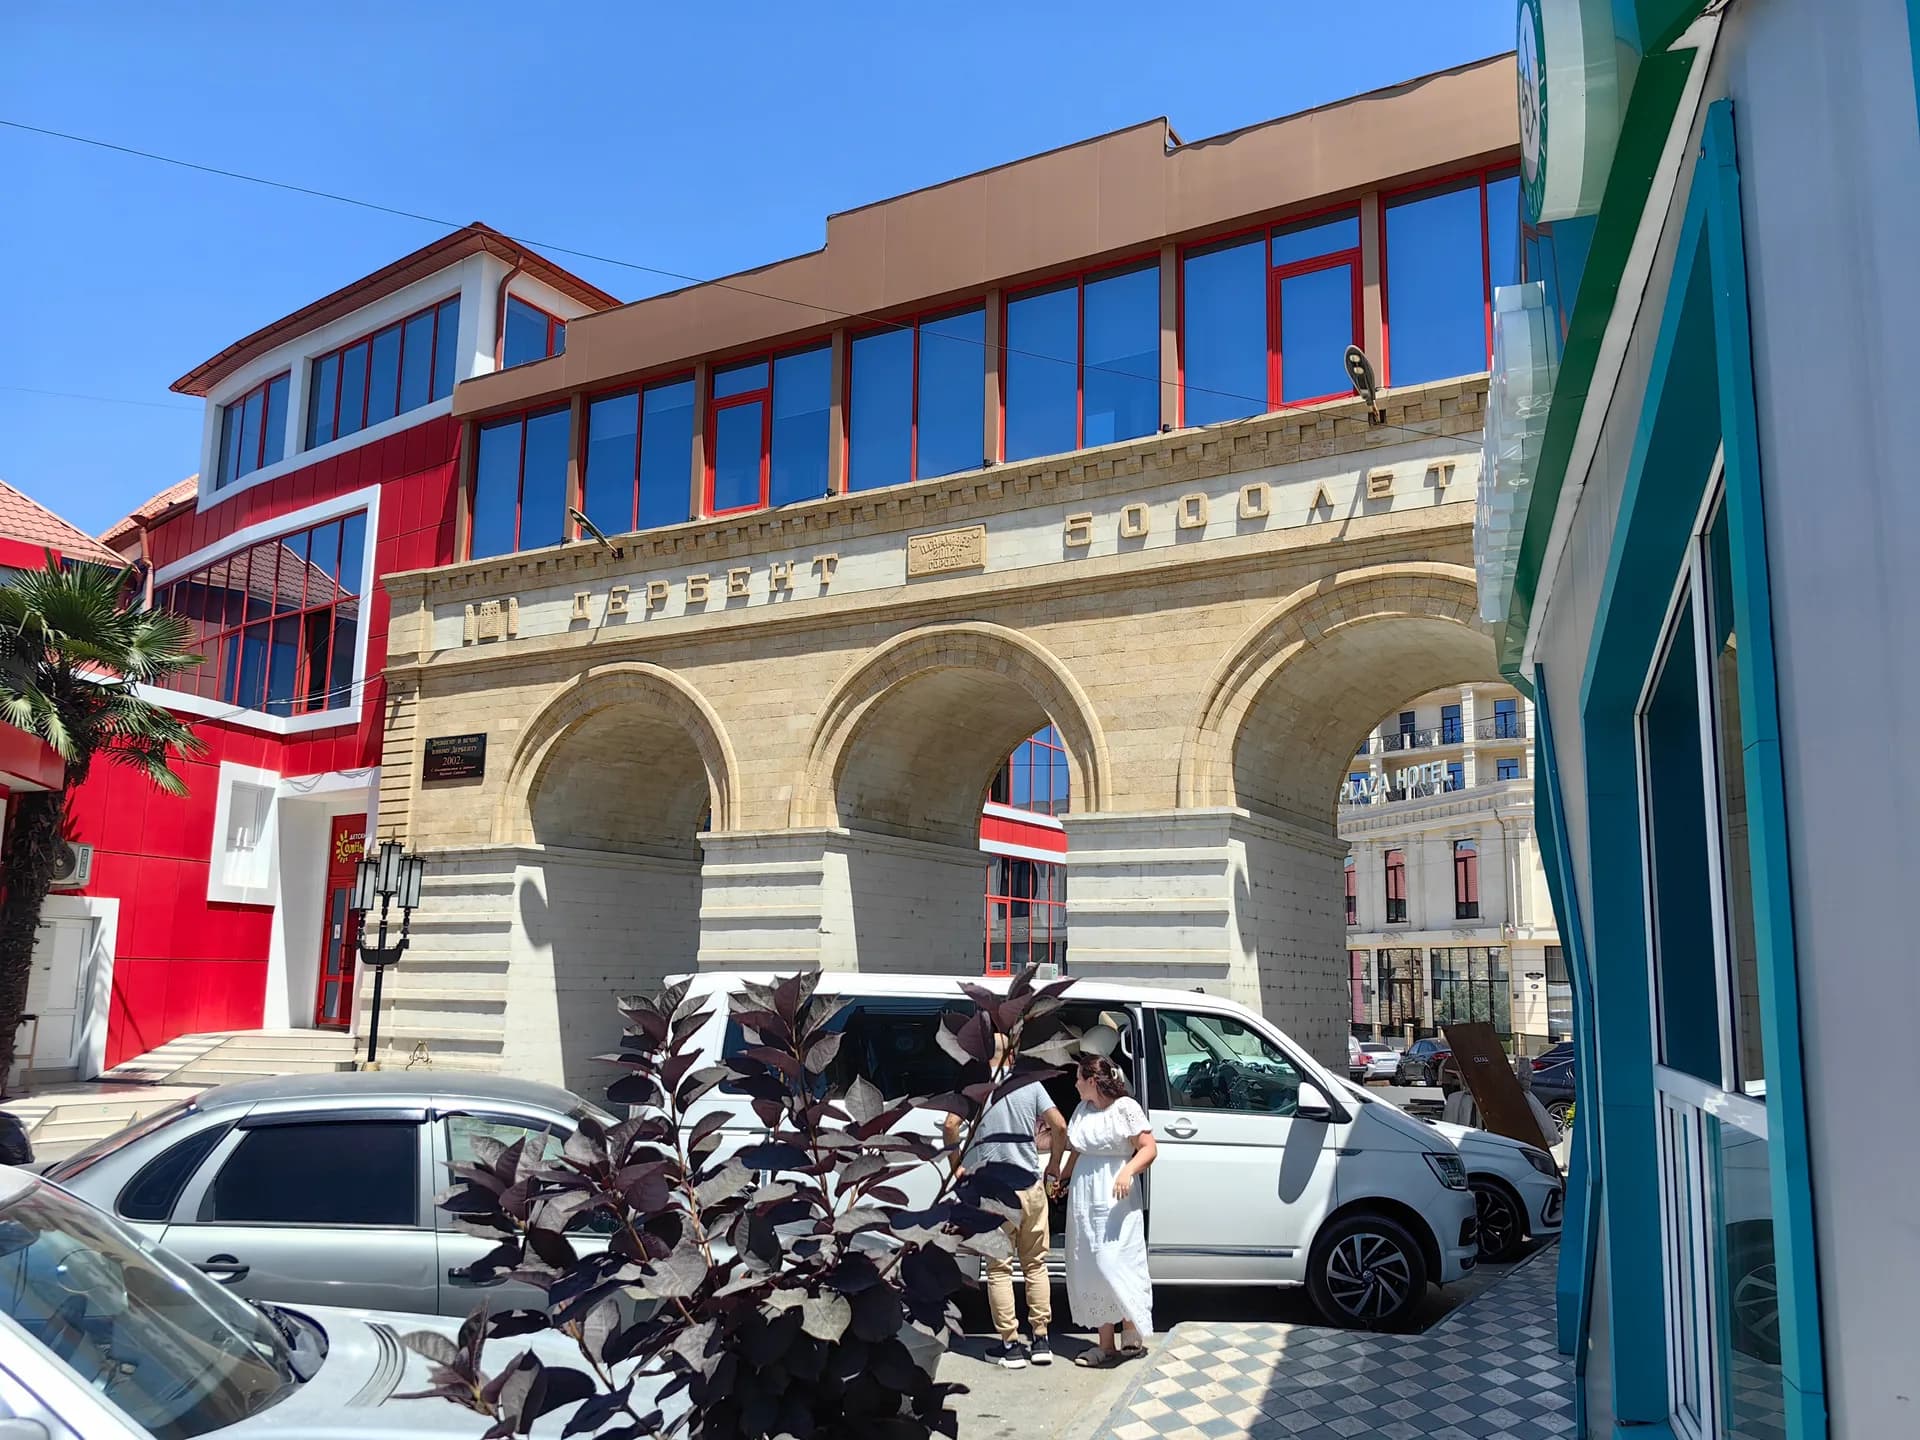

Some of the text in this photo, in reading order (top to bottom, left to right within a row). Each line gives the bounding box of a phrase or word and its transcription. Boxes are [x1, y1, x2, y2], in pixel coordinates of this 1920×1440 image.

[1064, 459, 1456, 547] 5000 ЛЕТ
[570, 553, 839, 620] ДЕРБЕНТ
[1339, 759, 1454, 802] PLAZA HOTEL
